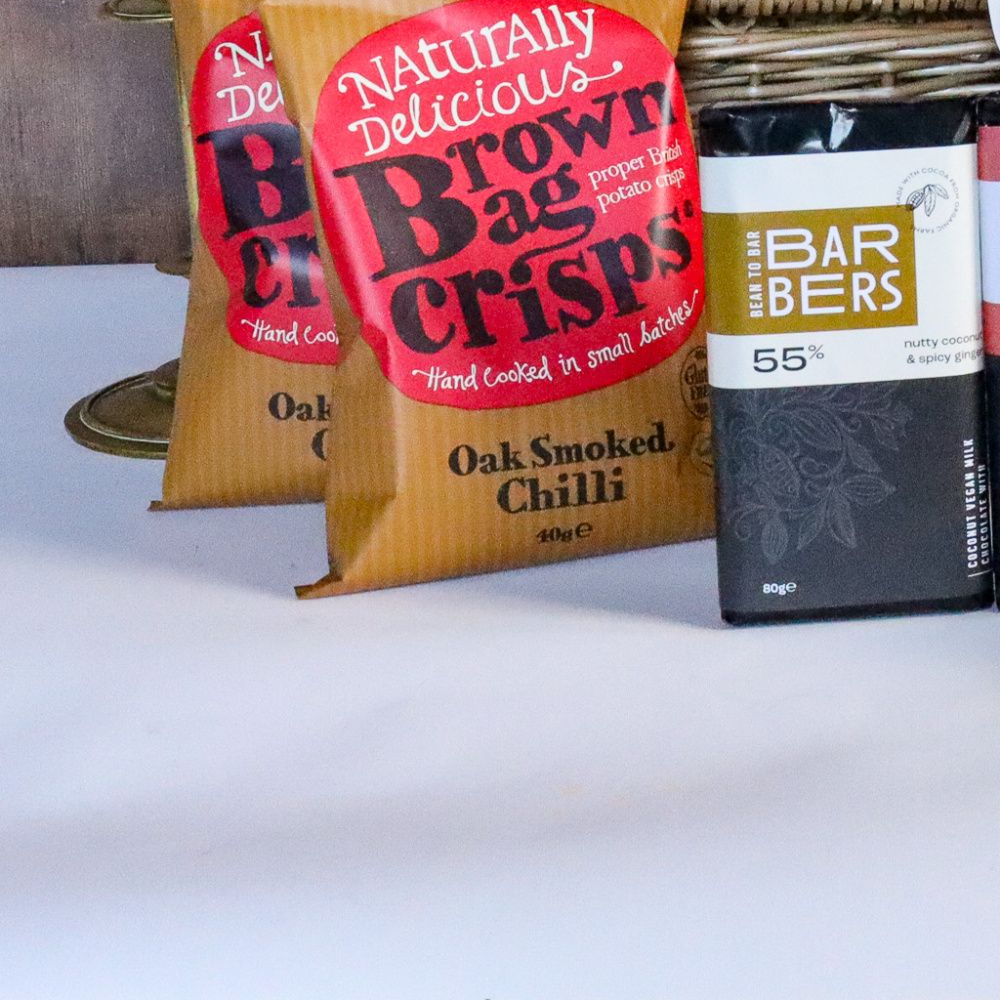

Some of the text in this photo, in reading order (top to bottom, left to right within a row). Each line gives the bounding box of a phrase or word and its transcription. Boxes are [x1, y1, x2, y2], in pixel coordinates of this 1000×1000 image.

[348, 60, 624, 157] Delicious
[588, 156, 646, 190] proper
[596, 165, 685, 214] potato crisps
[921, 167, 949, 180] COCOA
[765, 223, 900, 270] BAR
[746, 230, 764, 318] BEAN TO BAR
[767, 269, 904, 317] BERS
[240, 318, 299, 346] Hand
[412, 364, 479, 391] Hand
[558, 353, 582, 376] in
[587, 333, 635, 369] small
[639, 290, 699, 347] batches
[904, 337, 938, 349] nutty
[752, 344, 825, 374] 55%
[906, 354, 916, 364] &
[918, 352, 951, 365] spicy
[448, 421, 676, 476] Oak Smoked
[496, 467, 628, 515] Chilli
[963, 438, 978, 569] COCONUT VEGAN MILK
[978, 464, 990, 565] CHOCOLATE WITH
